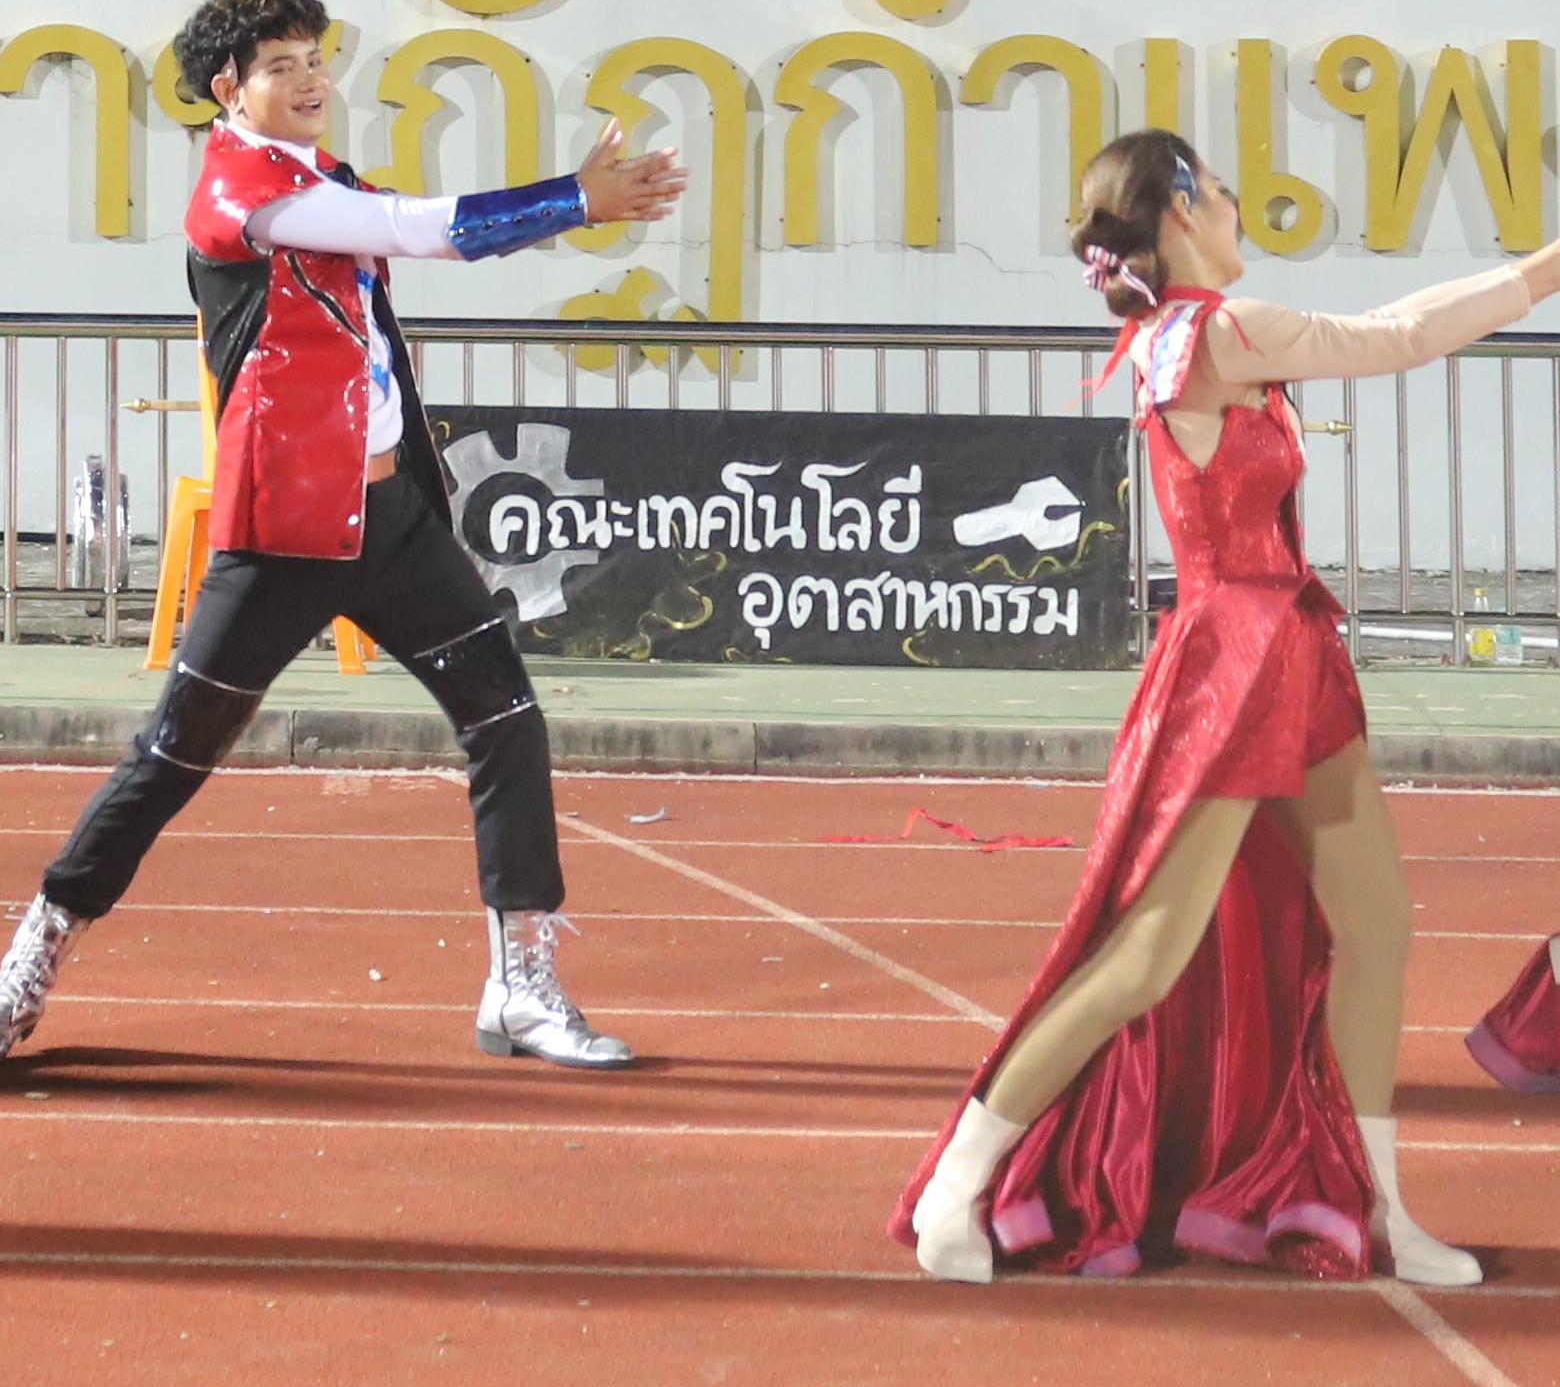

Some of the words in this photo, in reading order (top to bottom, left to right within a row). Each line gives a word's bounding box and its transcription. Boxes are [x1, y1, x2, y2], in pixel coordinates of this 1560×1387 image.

[488, 460, 922, 556] คณะเทคโนโลยี
[738, 569, 1078, 651] อุตสาหกรรม
